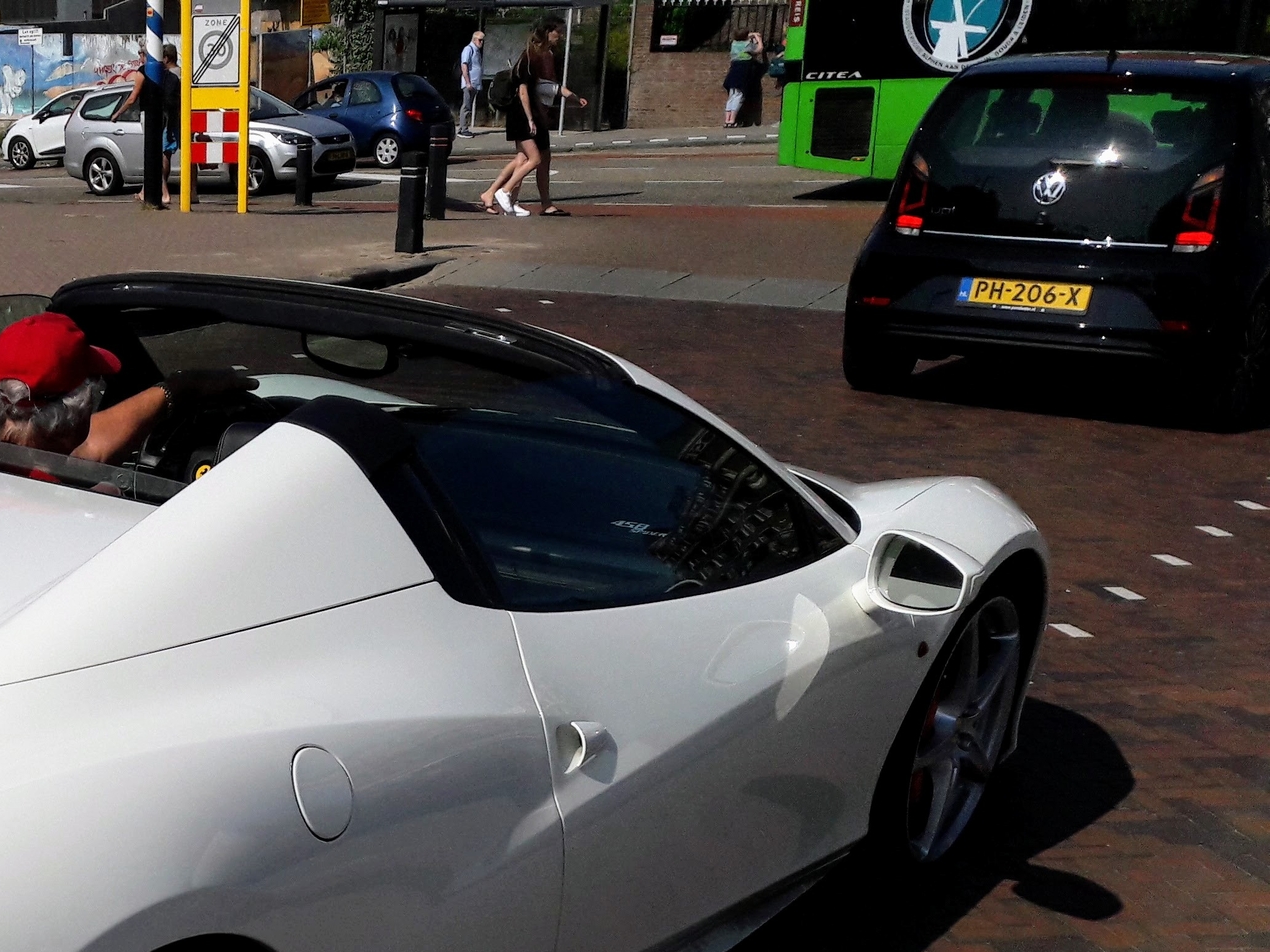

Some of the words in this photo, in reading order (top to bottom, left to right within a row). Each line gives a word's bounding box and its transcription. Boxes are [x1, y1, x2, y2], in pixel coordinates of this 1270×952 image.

[205, 19, 228, 27] ZONE
[805, 71, 862, 79] CITEA
[974, 281, 1081, 306] PH-206-X
